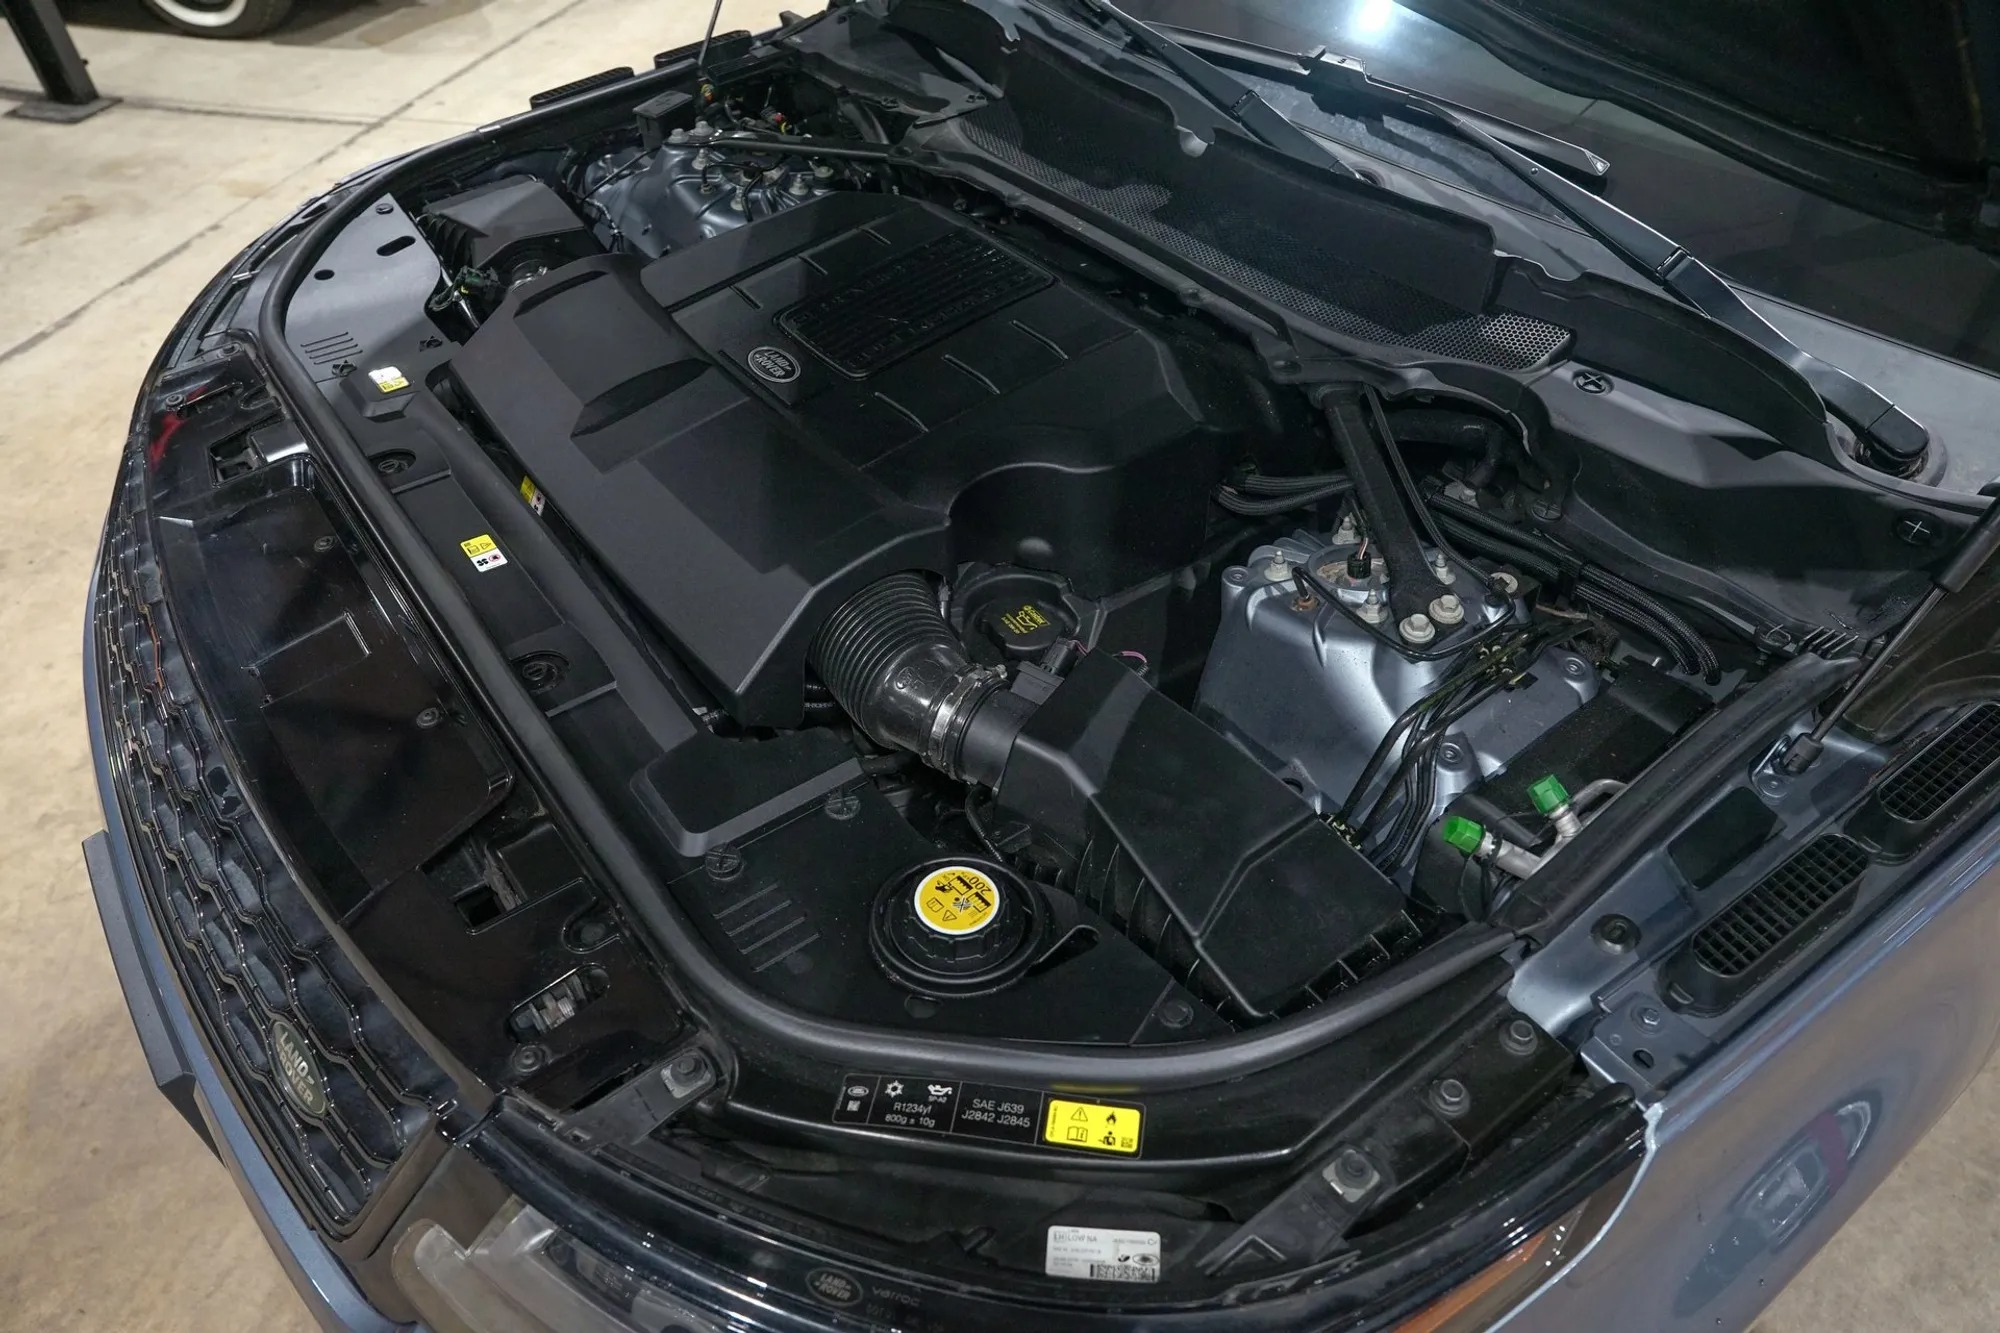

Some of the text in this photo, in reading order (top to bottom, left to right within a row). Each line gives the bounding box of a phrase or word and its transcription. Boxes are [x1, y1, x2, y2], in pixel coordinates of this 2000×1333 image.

[756, 356, 786, 377] ROVER
[764, 350, 790, 368] LAND
[968, 876, 992, 895] 200
[280, 1031, 309, 1078] LAND
[279, 1048, 314, 1106] ROVER
[893, 1101, 932, 1115] R1234yf
[972, 1098, 1025, 1115] SAE J639
[920, 1116, 936, 1128] 10g
[961, 1109, 1031, 1128] J2842 J2845
[820, 1272, 847, 1288] LAND
[819, 1283, 852, 1301] ROVER
